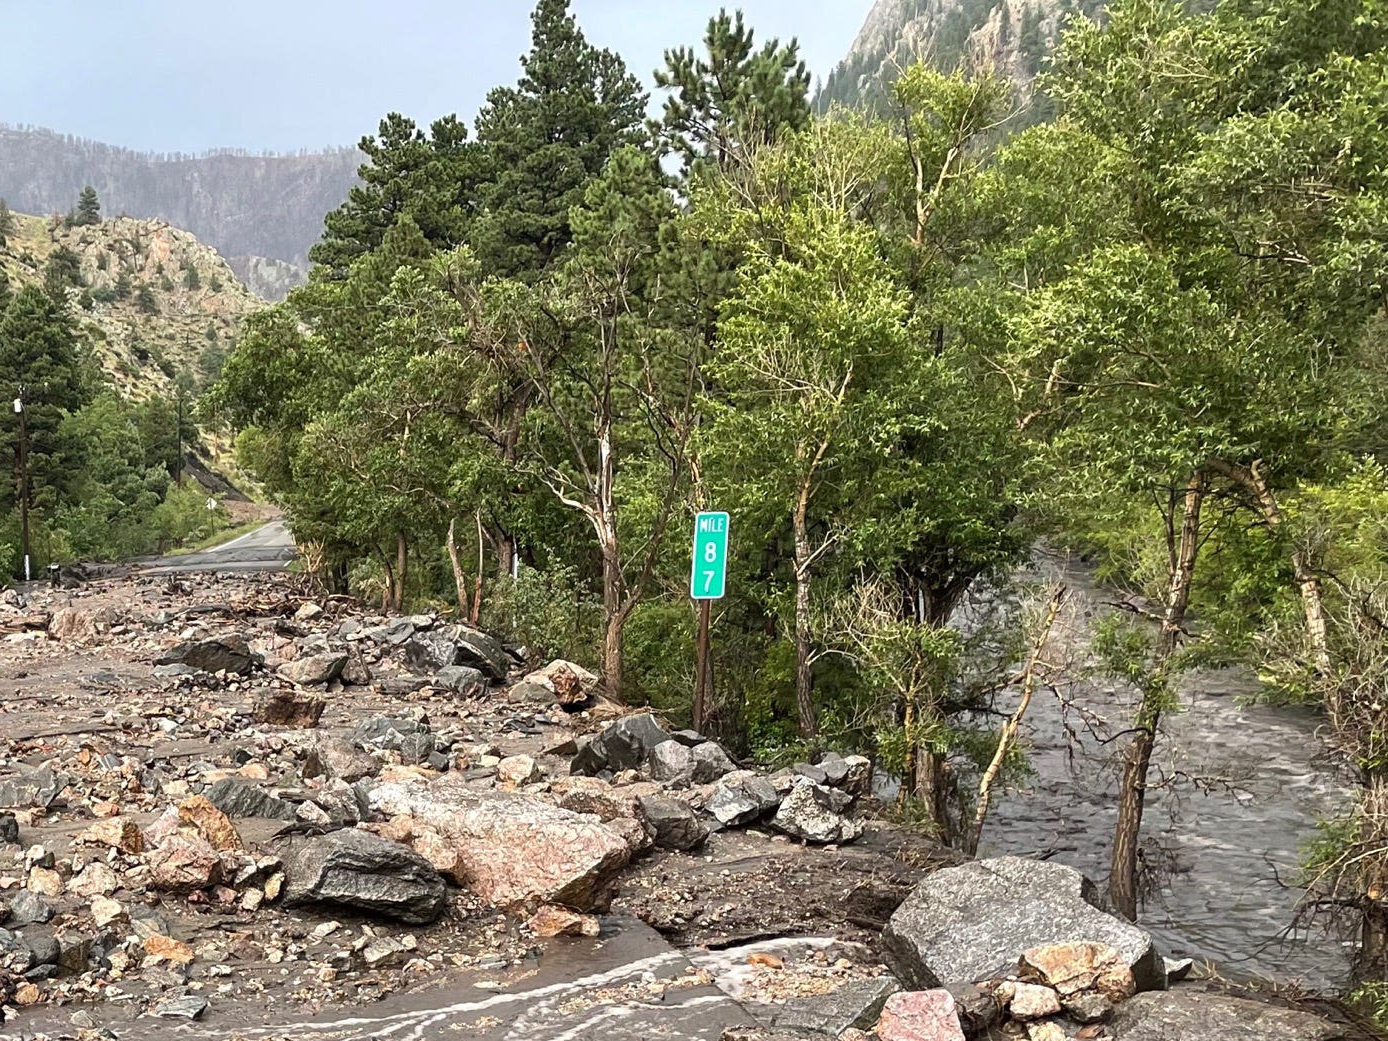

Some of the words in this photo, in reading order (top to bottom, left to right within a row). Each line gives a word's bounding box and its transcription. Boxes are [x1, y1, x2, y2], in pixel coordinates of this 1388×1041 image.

[699, 518, 724, 532] MILE
[704, 542, 717, 563] 8
[703, 571, 715, 592] 7
